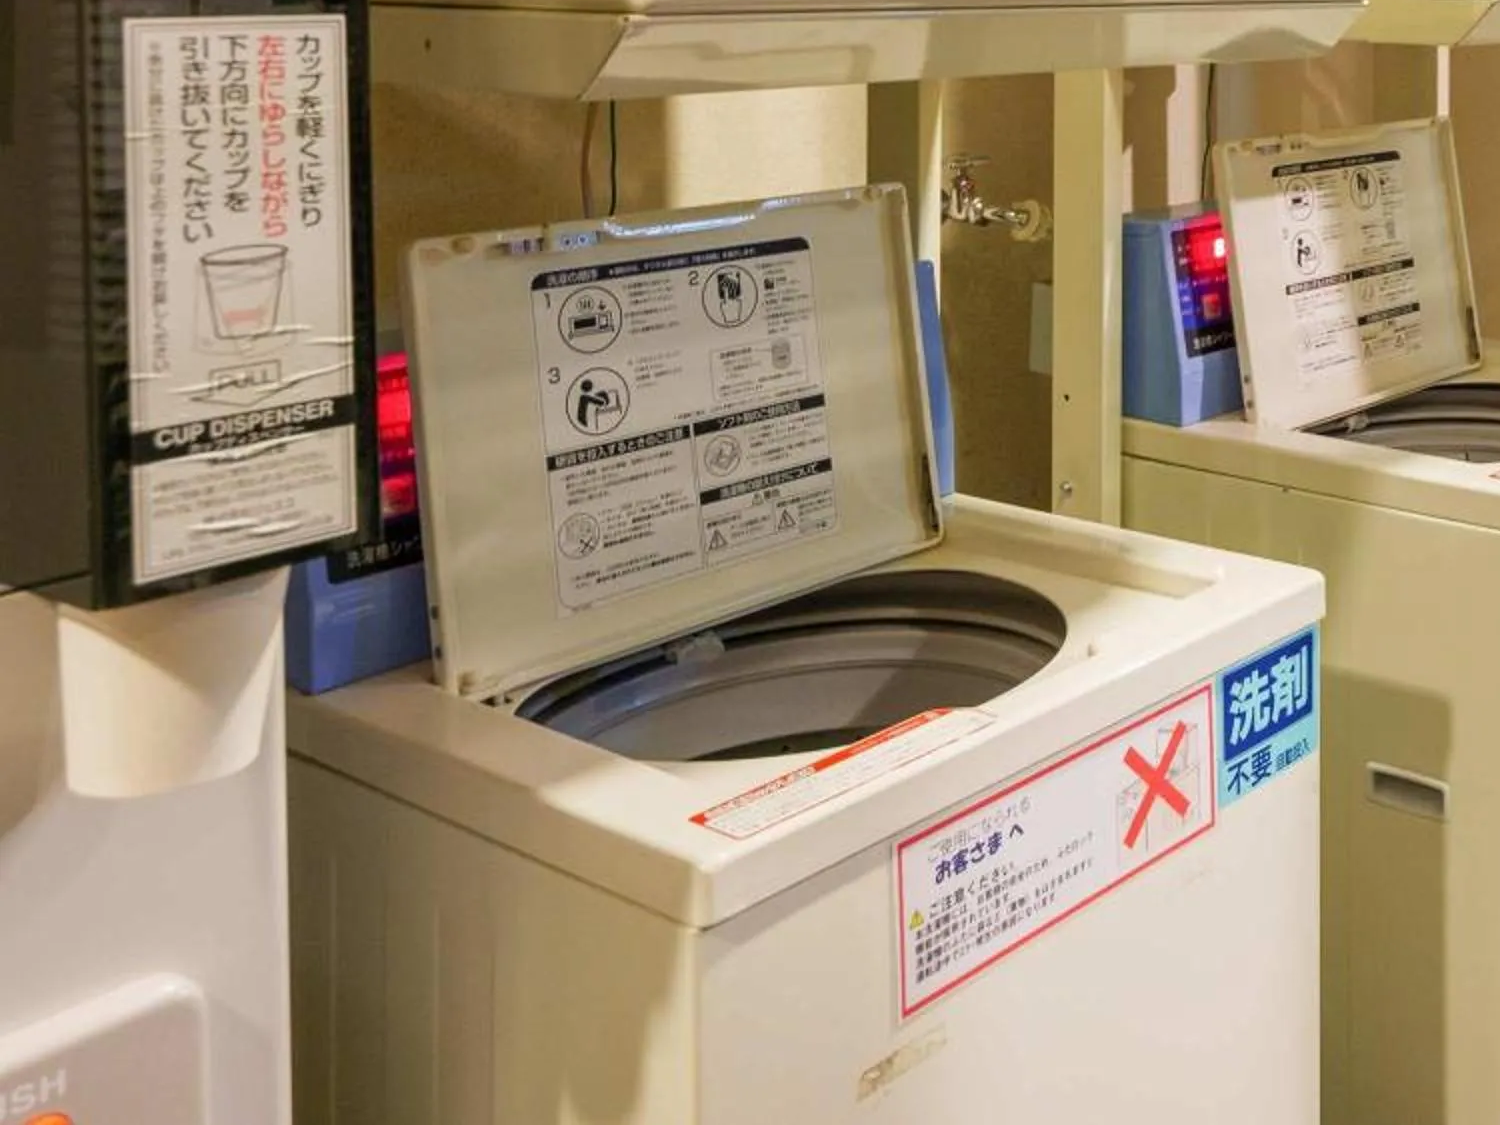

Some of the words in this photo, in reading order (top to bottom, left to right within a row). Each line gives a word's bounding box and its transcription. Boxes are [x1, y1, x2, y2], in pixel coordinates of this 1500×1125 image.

[179, 35, 214, 244] 引き抜いてください
[217, 34, 250, 213] 下方向にカップを
[256, 35, 289, 239] 左右にゆらしながら
[296, 34, 325, 228] カップを軽くにぎり
[687, 270, 700, 287] 2
[547, 366, 561, 385] 3
[154, 424, 205, 450] CUP
[209, 398, 335, 437] DISPENSER
[1229, 644, 1309, 746] 洗剤
[1227, 744, 1273, 796] 不要
[934, 830, 1004, 885] お客さま
